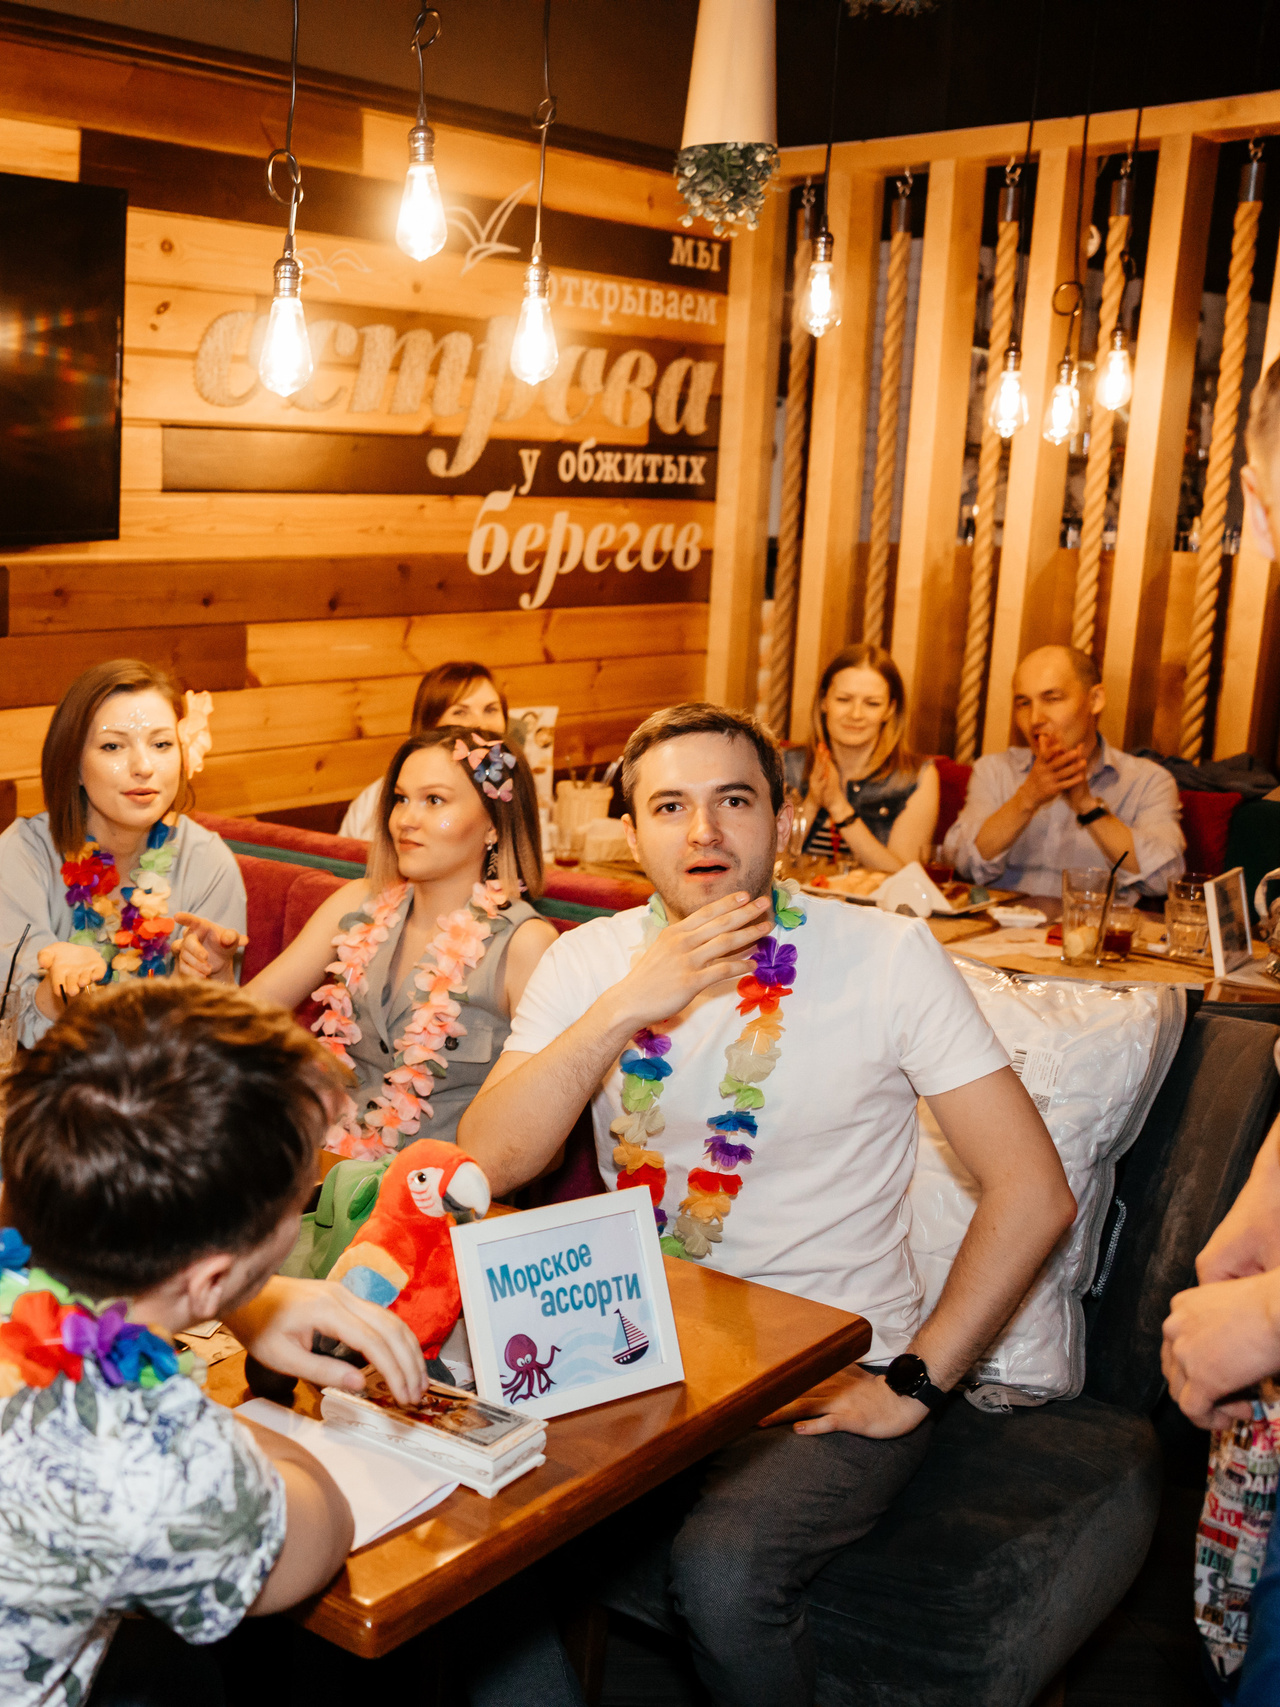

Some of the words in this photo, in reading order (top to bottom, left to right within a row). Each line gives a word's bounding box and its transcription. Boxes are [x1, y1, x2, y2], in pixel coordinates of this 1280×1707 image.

[670, 234, 723, 273] мы
[518, 448, 542, 496] у
[557, 436, 708, 486] обжитых
[466, 484, 704, 611] берегов
[485, 1243, 593, 1303] Морское
[539, 1272, 642, 1318] ассорти
